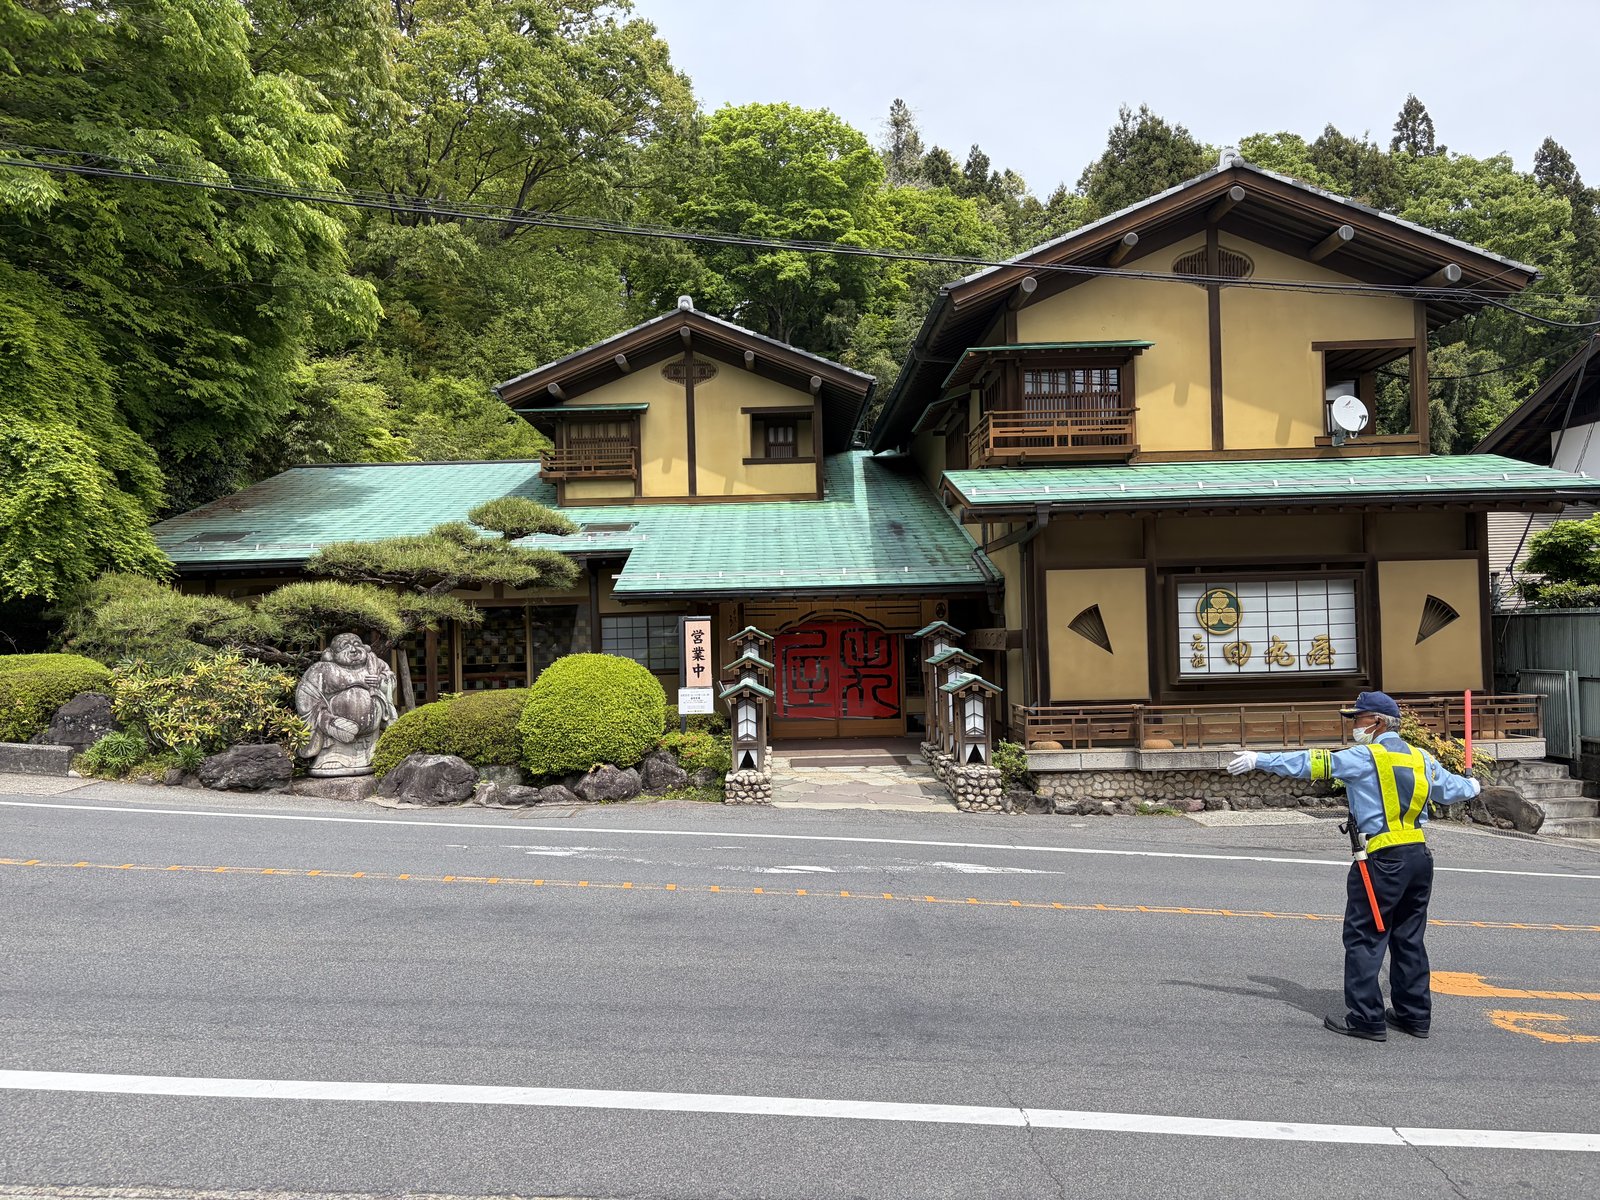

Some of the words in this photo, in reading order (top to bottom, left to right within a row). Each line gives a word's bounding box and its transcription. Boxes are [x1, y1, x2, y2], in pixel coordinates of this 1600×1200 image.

[691, 629, 705, 679] 営業中
[1191, 633, 1206, 669] 元祖
[1223, 634, 1336, 666] 田丸屋
